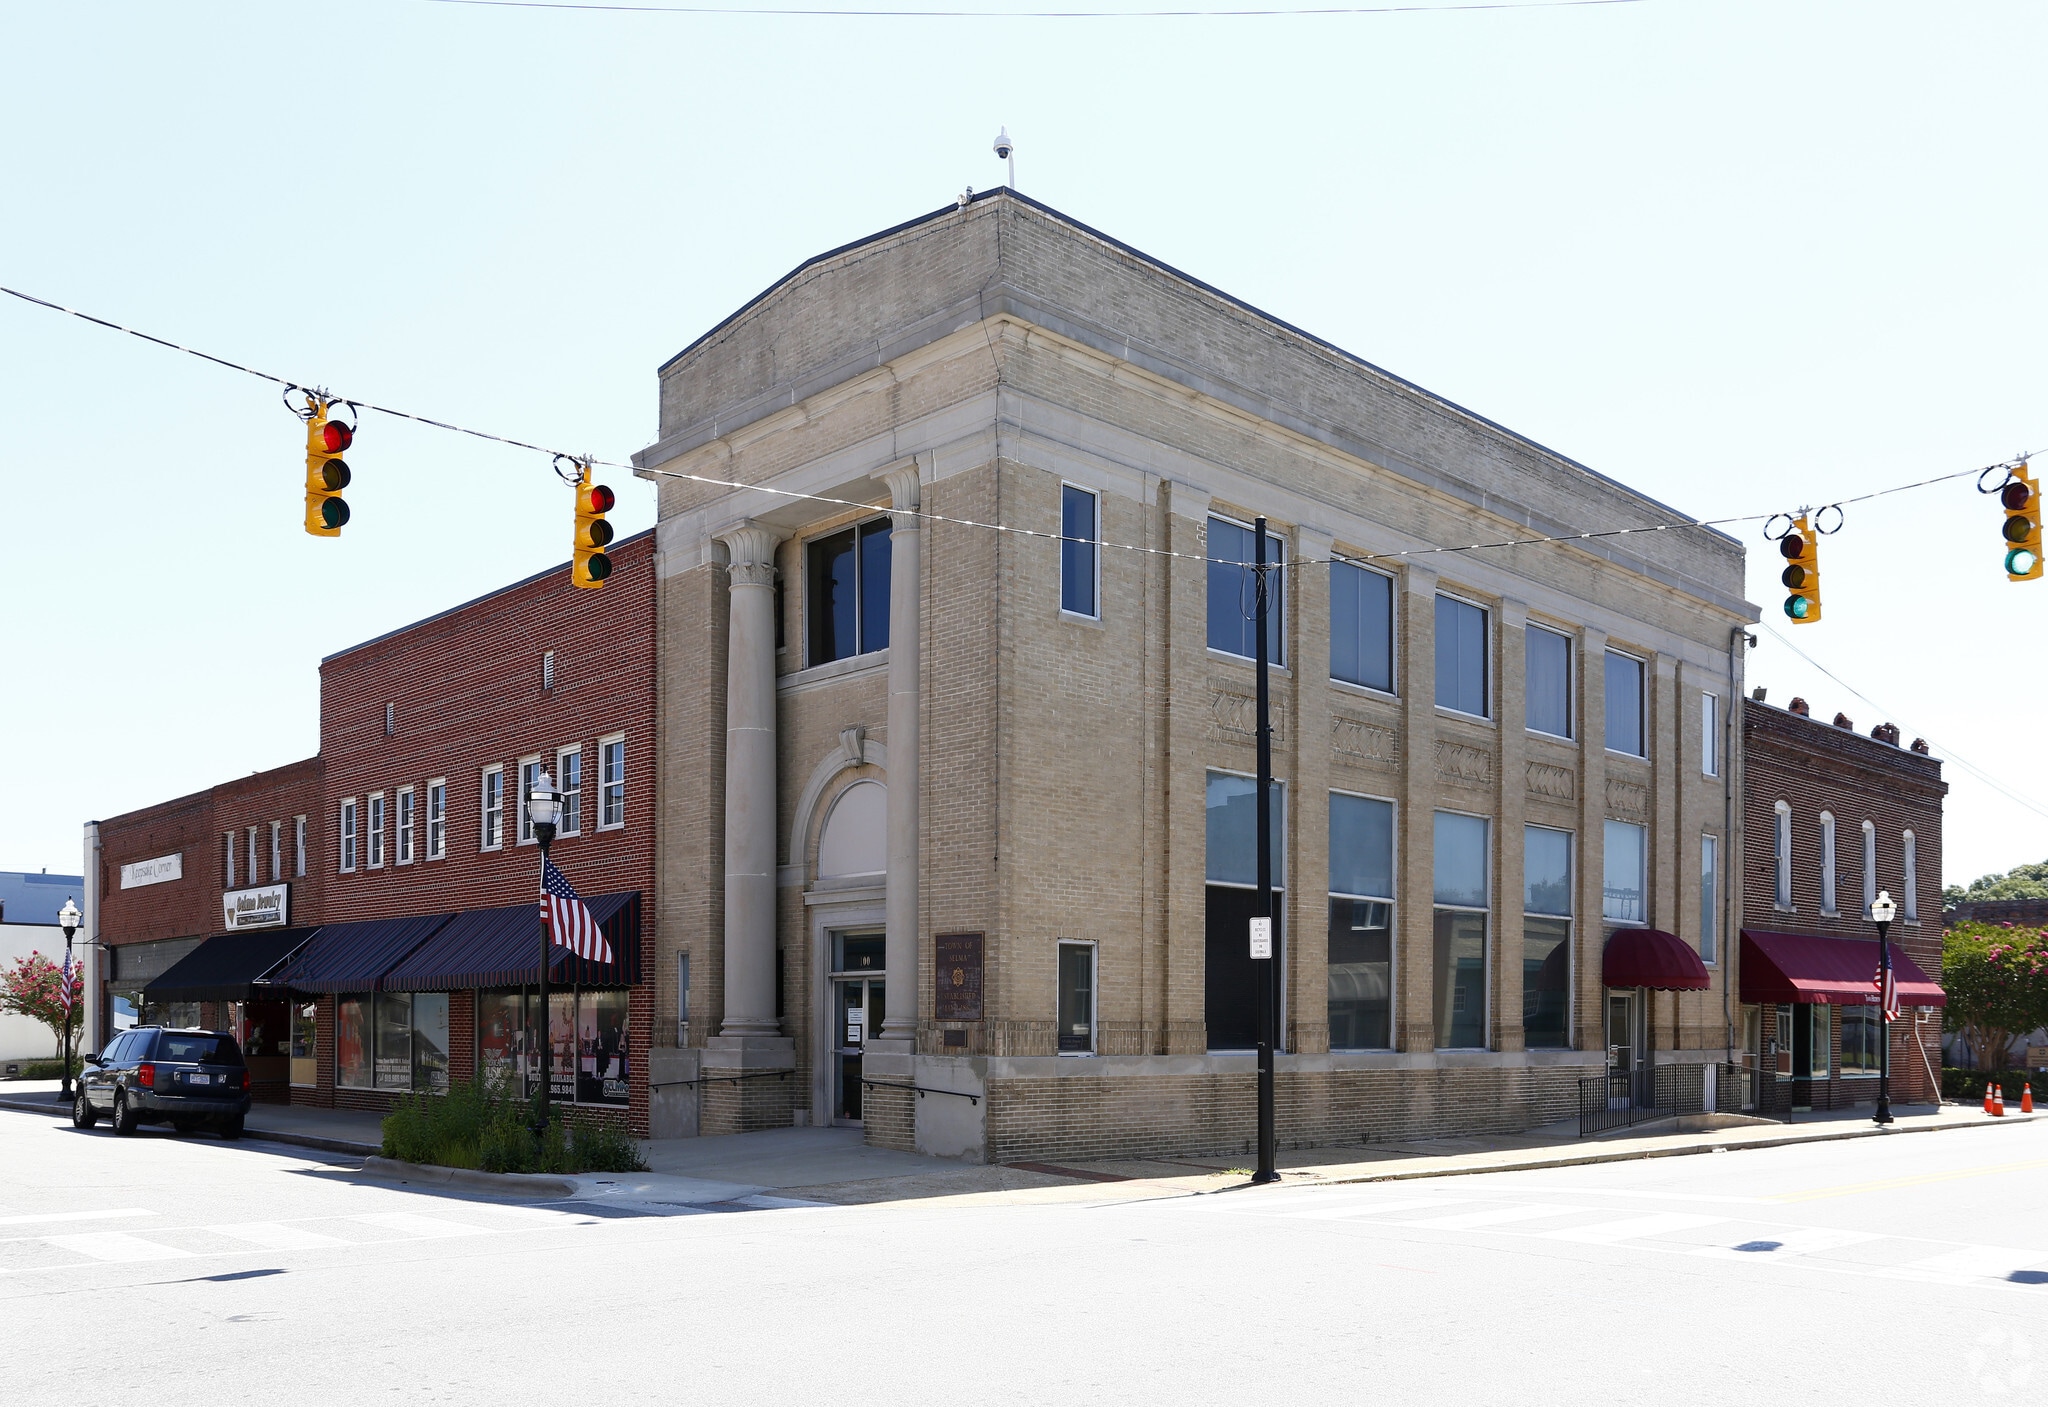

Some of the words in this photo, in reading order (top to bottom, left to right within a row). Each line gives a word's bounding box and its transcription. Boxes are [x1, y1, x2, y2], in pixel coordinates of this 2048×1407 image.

[153, 859, 172, 878] Corner
[257, 890, 281, 911] Jewelry
[944, 942, 962, 950] TOWN
[965, 942, 973, 950] OF
